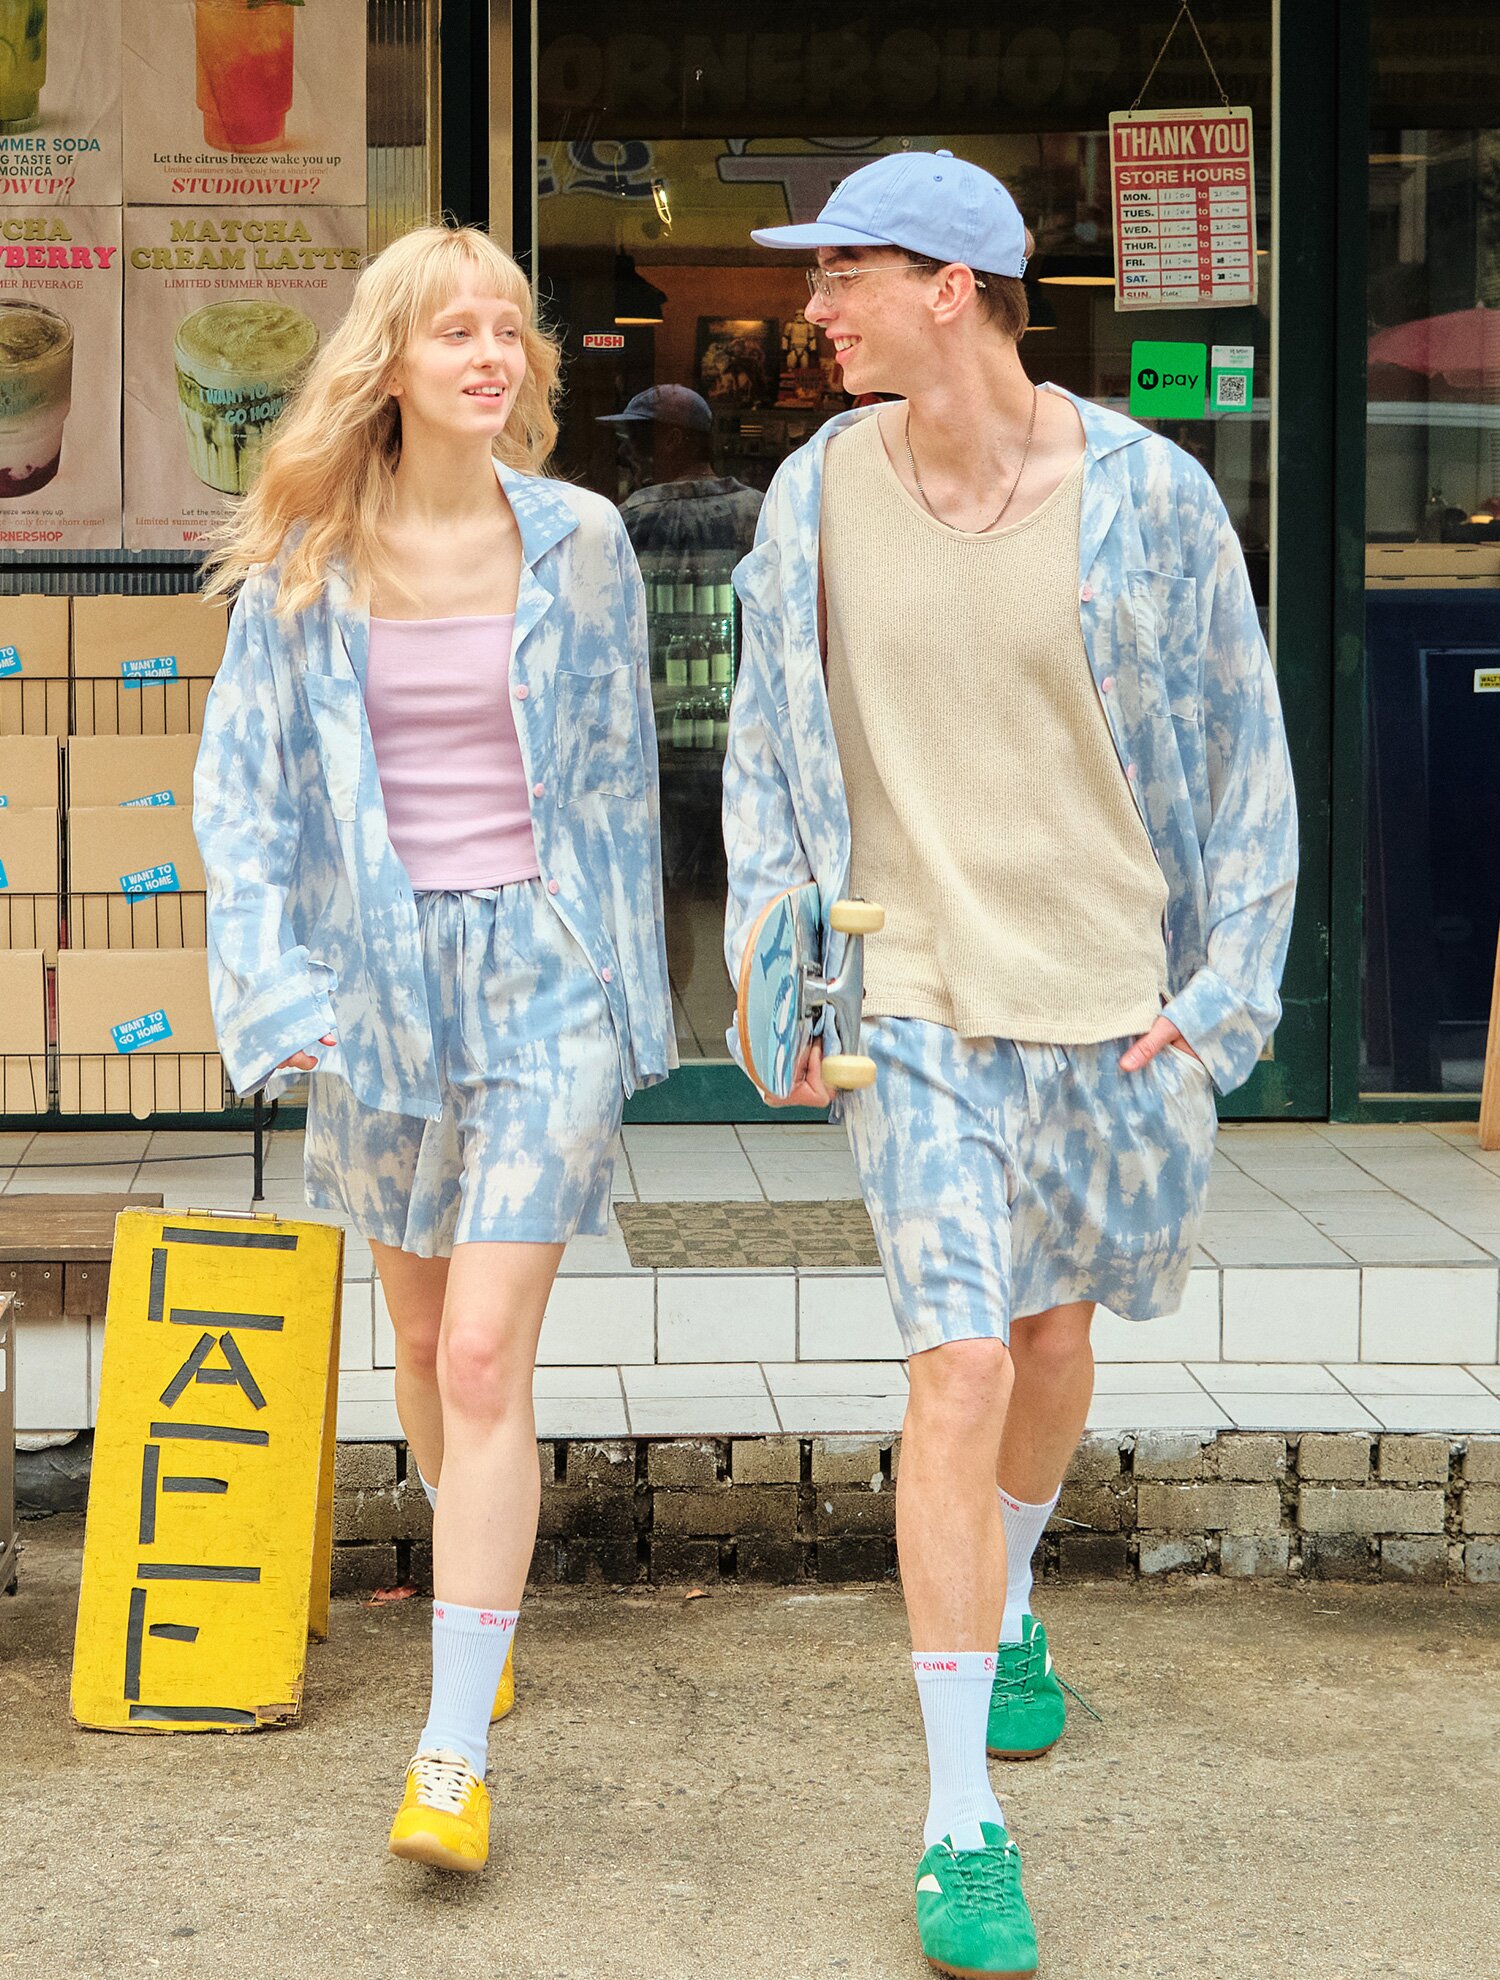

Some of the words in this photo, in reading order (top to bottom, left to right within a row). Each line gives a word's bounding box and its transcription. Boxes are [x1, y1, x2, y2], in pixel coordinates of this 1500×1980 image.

[0, 138, 46, 152] MMER
[53, 138, 100, 152] SODA
[1117, 125, 1196, 158] THANK
[1200, 123, 1246, 154] YOU
[14, 155, 51, 165] TASTE
[56, 154, 73, 165] OF
[153, 153, 171, 164] Let
[174, 153, 192, 164] the
[195, 153, 228, 164] citrus
[231, 153, 268, 165] breeze
[271, 153, 300, 165] wake
[302, 156, 322, 167] you
[327, 156, 341, 167] up
[0, 166, 52, 176] MONICA
[1119, 170, 1179, 185] STORE
[1183, 167, 1246, 182] HOURS
[172, 177, 320, 194] STUDIOWUP?
[1123, 193, 1151, 201] MON.
[1123, 209, 1154, 217] TUES.
[0, 217, 72, 241] CHA
[170, 219, 312, 242] MATCHA
[1124, 226, 1151, 234] WED.
[1124, 242, 1157, 250] THUR.
[130, 247, 246, 270] CREAM
[255, 247, 362, 270] LATTE
[1125, 259, 1145, 267] FRI.
[22, 280, 84, 289] BEVERAGE
[164, 279, 211, 289] LIMITED
[214, 279, 263, 289] SUMMER
[267, 279, 328, 289] BEVERAGE
[1125, 275, 1148, 283] SAT.
[1126, 291, 1151, 299] SUN.
[585, 336, 622, 346] PUSH
[1163, 374, 1198, 389] pay
[225, 409, 247, 425] GO
[250, 397, 286, 421] HOM
[136, 518, 168, 526] Limited
[0, 531, 63, 542] RNERSHOP
[0, 647, 14, 657] TO
[123, 662, 127, 672] I
[130, 659, 156, 671] WANT
[159, 657, 173, 667] TO
[145, 667, 172, 677] HOME
[155, 792, 170, 803] TO
[122, 878, 127, 887] I
[128, 869, 154, 884] WANT
[157, 864, 172, 875] TO
[145, 874, 173, 890] HOME
[113, 1028, 118, 1037] I
[119, 1017, 145, 1034] WANT
[148, 1012, 163, 1023] TO
[119, 1033, 134, 1044] GO
[136, 1021, 165, 1039] HOME
